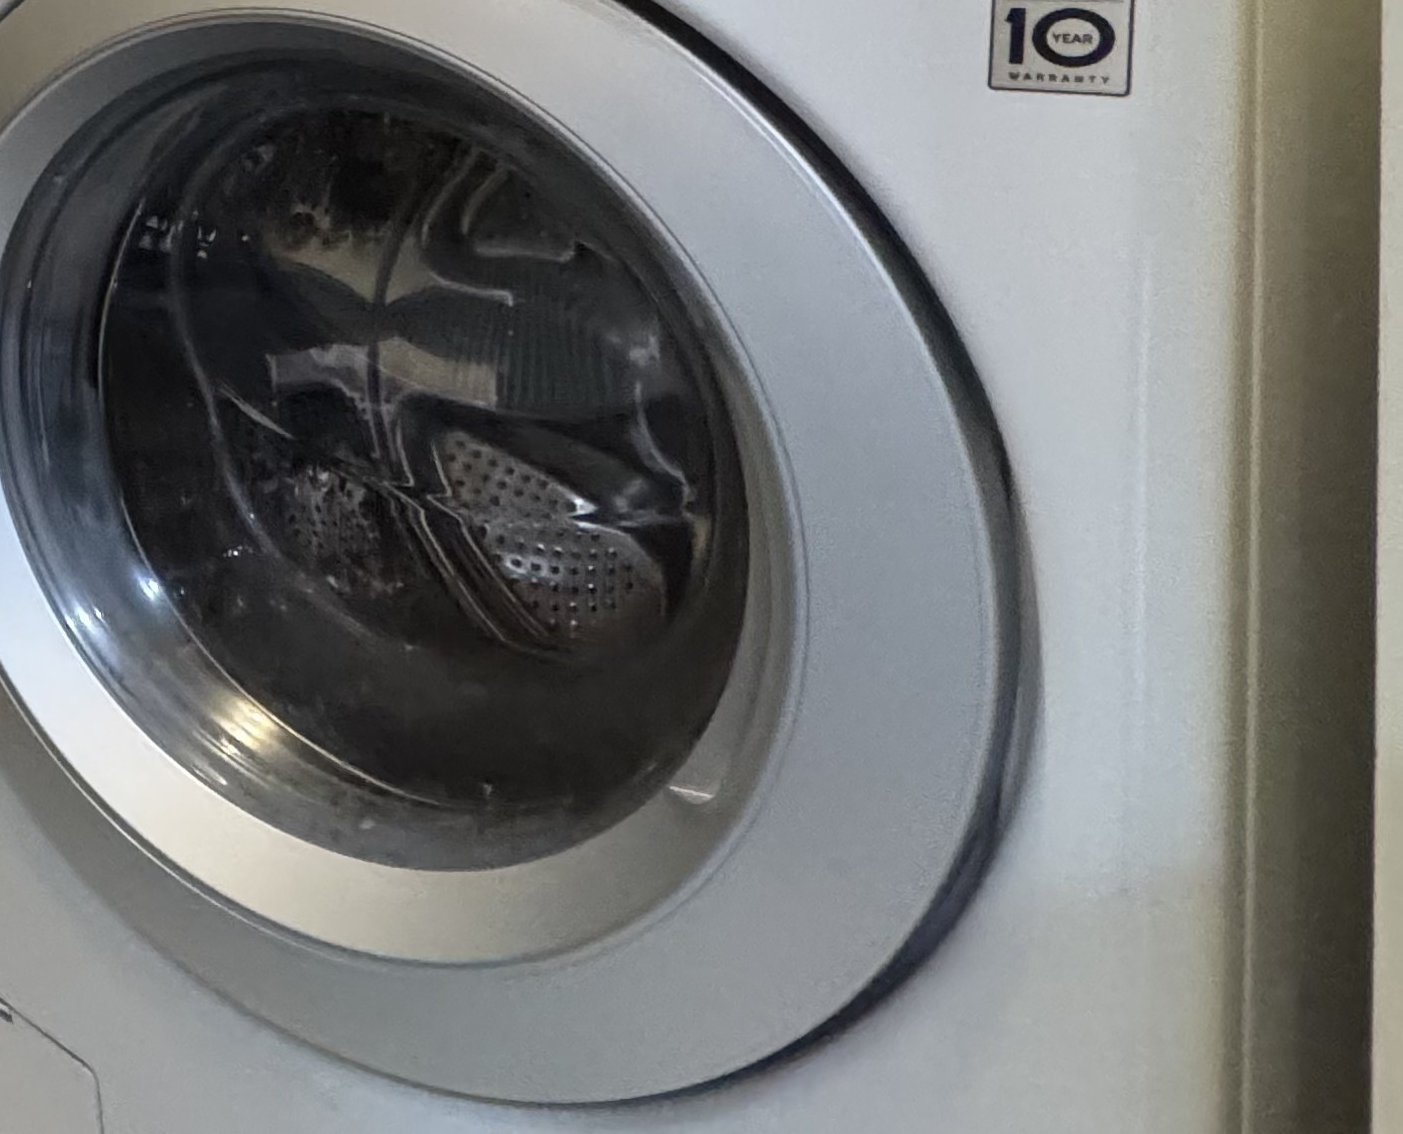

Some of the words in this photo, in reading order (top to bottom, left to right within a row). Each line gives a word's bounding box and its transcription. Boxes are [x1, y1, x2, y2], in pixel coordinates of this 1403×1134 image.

[1005, 7, 1116, 68] 10
[1052, 33, 1093, 44] YEAR
[1008, 71, 1110, 84] WARRANTY
